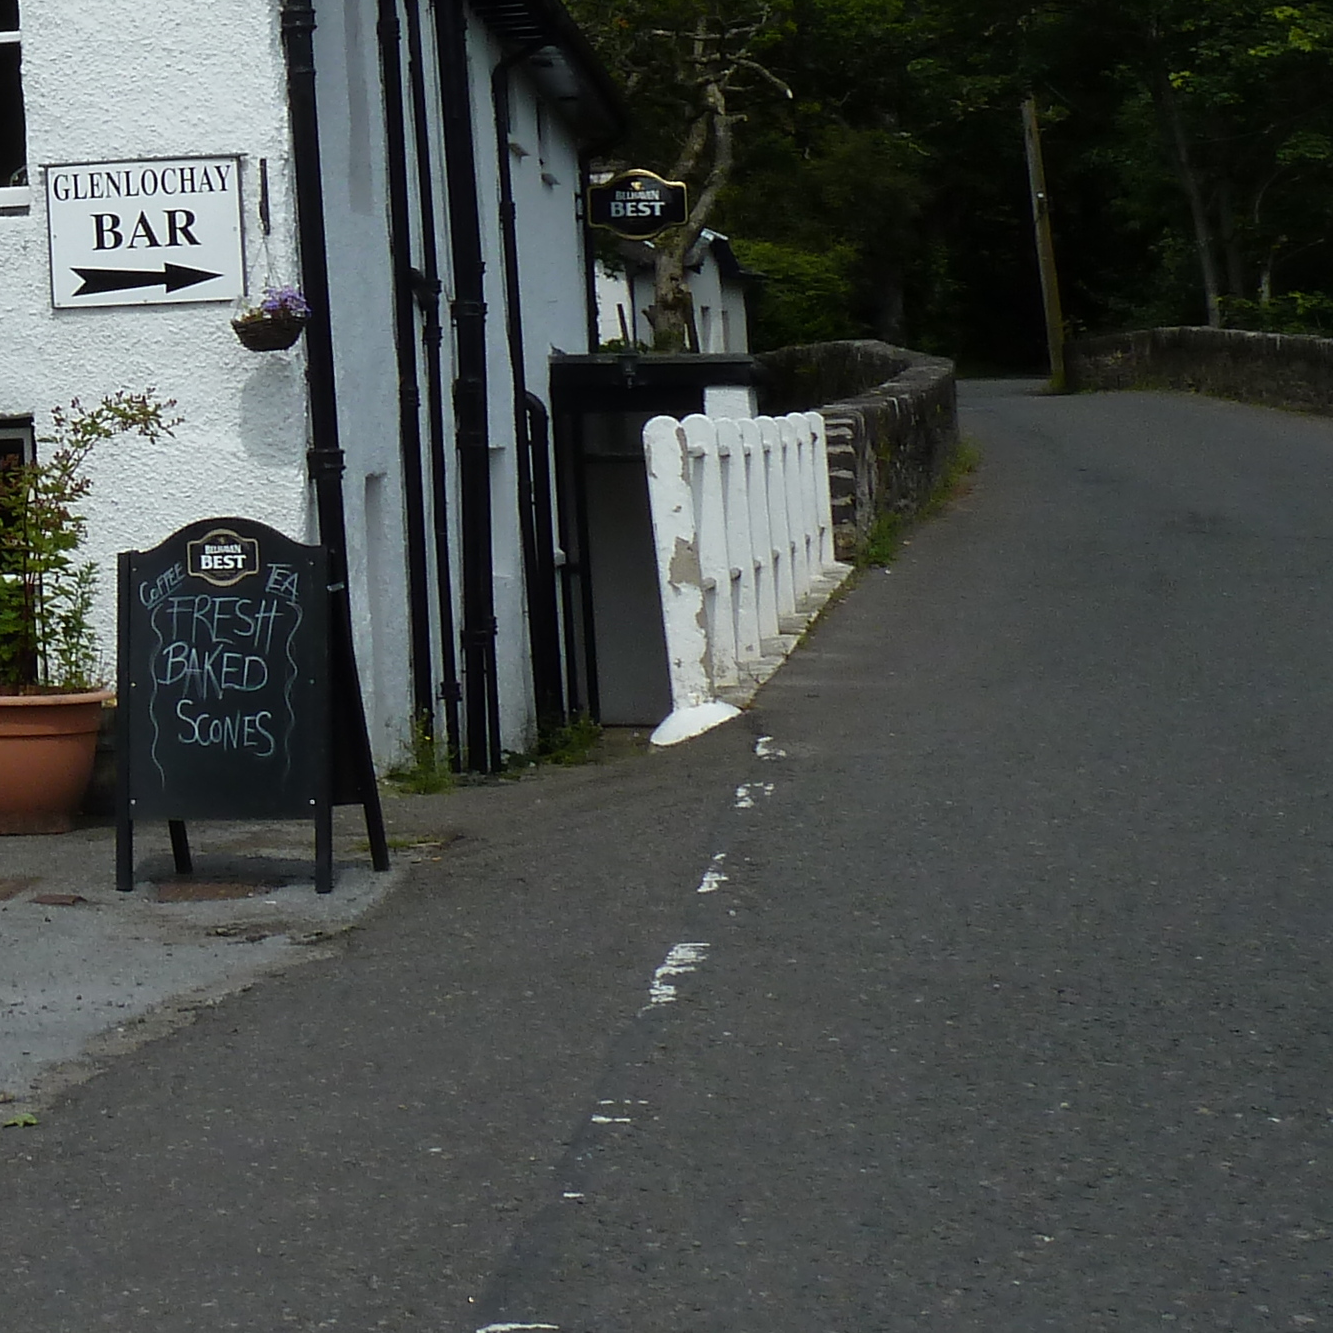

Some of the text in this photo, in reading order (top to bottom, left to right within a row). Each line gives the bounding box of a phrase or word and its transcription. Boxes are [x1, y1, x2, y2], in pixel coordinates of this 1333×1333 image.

[53, 165, 231, 202] GLENLOCHAY
[610, 201, 666, 217] BEST
[90, 209, 202, 251] BAR
[201, 555, 247, 570] BEST
[265, 564, 300, 601] TEA
[166, 595, 284, 655] FRESH
[157, 641, 269, 700] BAKED
[176, 699, 275, 757] SCONES
